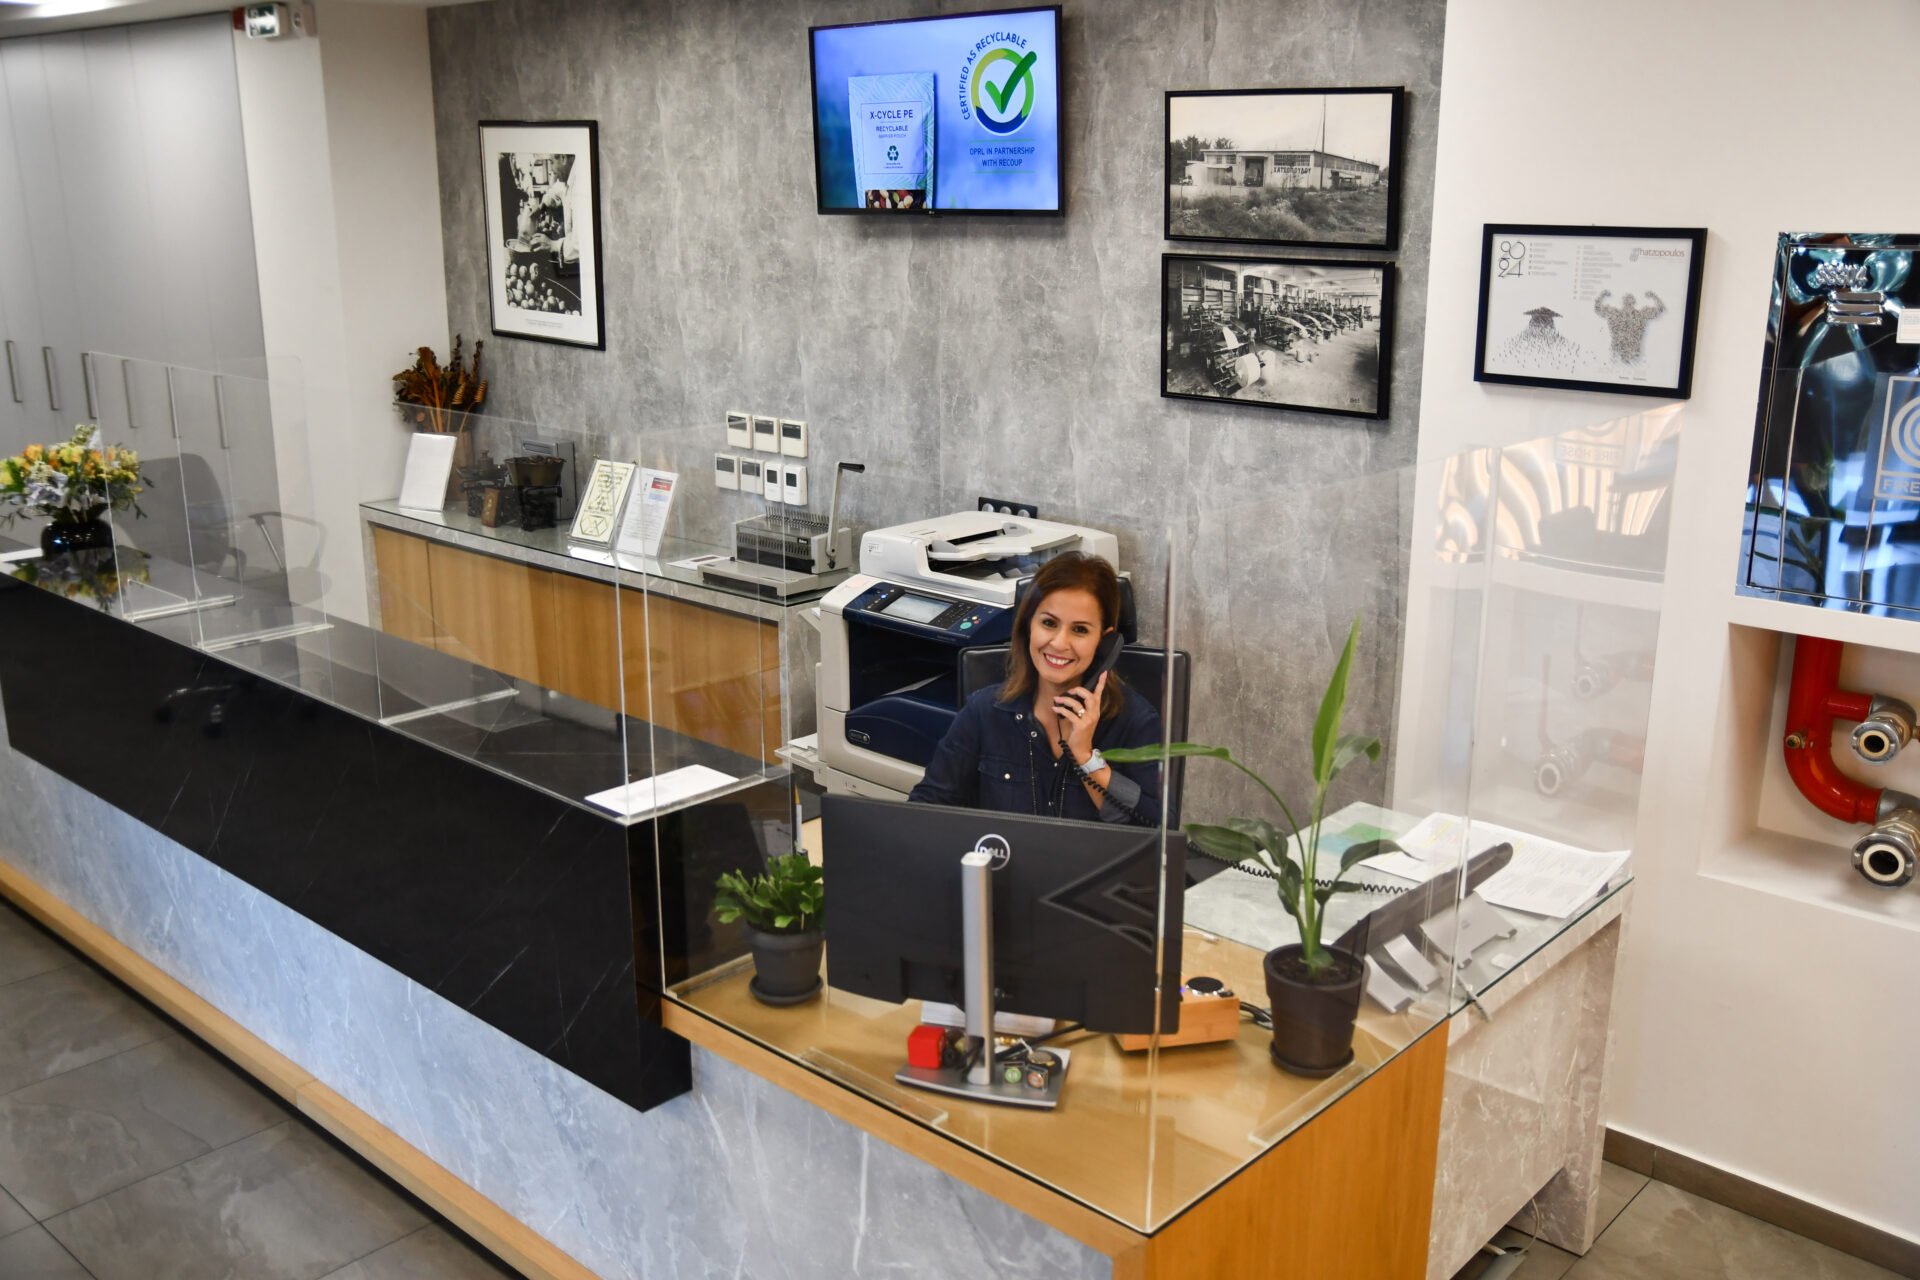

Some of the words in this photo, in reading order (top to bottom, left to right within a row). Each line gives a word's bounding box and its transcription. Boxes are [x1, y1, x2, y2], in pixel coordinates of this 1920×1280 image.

[959, 66, 971, 120] CERTIFIED
[967, 50, 977, 65] AS
[975, 32, 1027, 52] RECYCLABLE
[870, 110, 901, 119] X-CYCLE
[903, 110, 913, 118] PE
[986, 147, 993, 155] IN
[994, 146, 1036, 155] PARTNERSHIP
[982, 159, 998, 167] WITH
[998, 158, 1023, 167] RECOUP
[1640, 248, 1685, 258] hatzopoulos
[1883, 479, 1920, 494] FIRE
